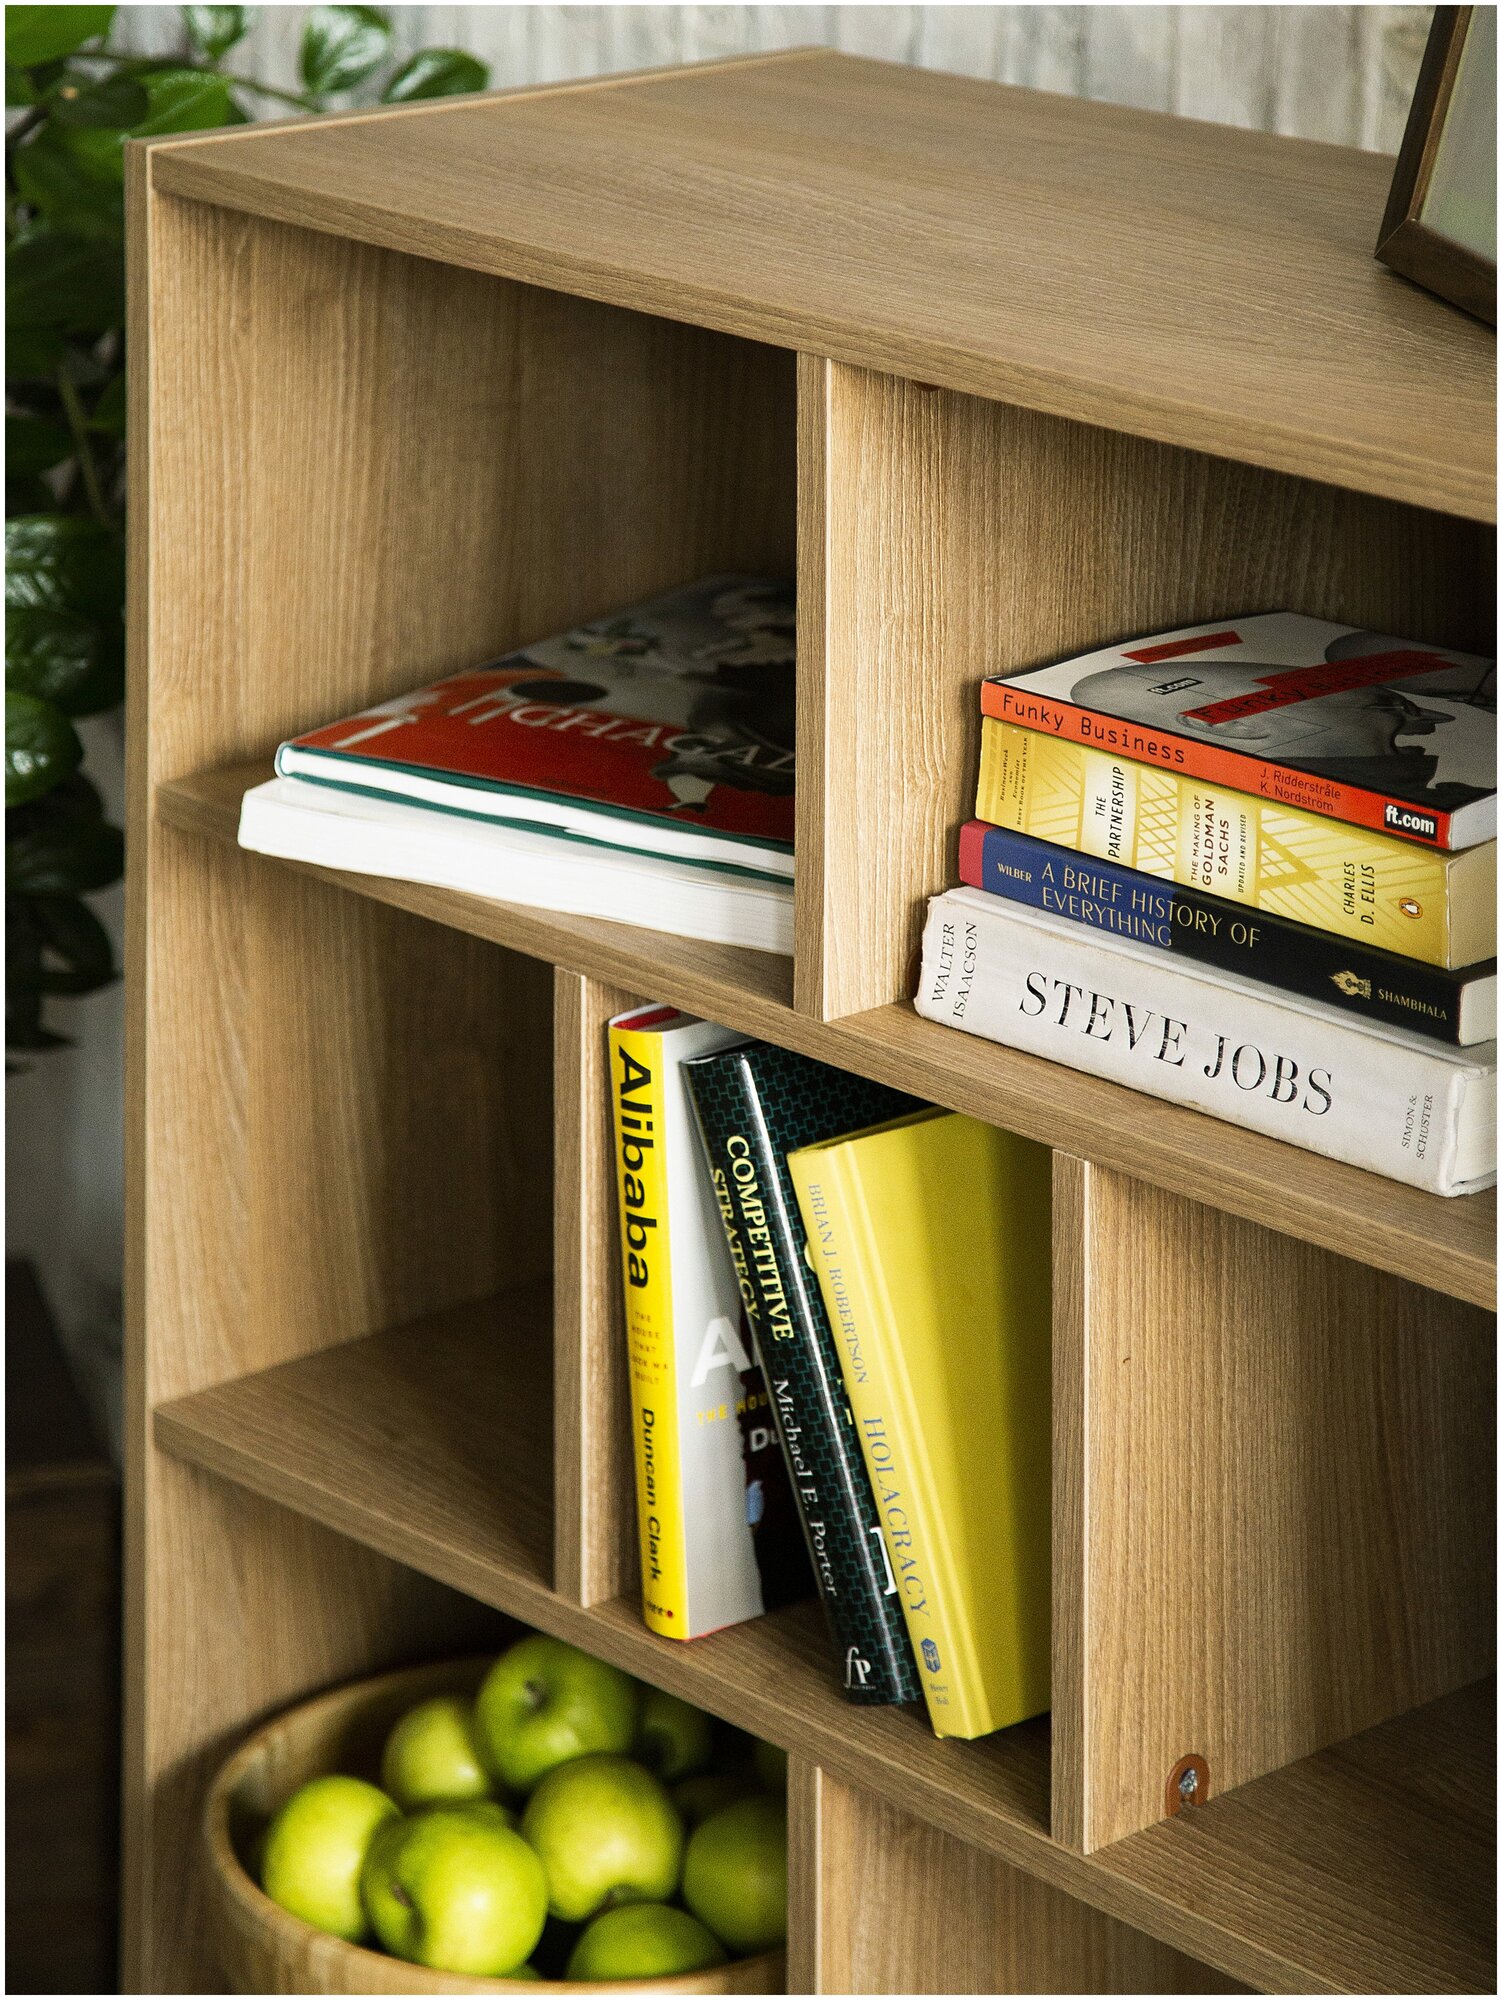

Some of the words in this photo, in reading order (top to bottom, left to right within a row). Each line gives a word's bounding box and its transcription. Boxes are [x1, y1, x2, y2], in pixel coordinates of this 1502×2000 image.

[509, 703, 796, 775] CHAGAL
[1002, 693, 1064, 732] Funky
[1081, 716, 1186, 764] Business
[1095, 796, 1106, 816] THE
[1108, 766, 1125, 858] PARTNERSHIP
[1194, 794, 1201, 810] OF
[1260, 767, 1269, 779] J.
[1273, 770, 1341, 800] Ridderstråle
[1260, 781, 1272, 795] K.
[1274, 785, 1334, 812] Nordström
[1193, 813, 1201, 856] MAKING
[1202, 799, 1215, 886] GOLDMAN
[1218, 819, 1230, 876] SACHS
[1385, 804, 1435, 835] ft.com
[997, 861, 1033, 883] WILBER
[1042, 862, 1055, 883] A
[1063, 866, 1123, 903] BRIEF
[1132, 889, 1222, 936] HISTORY
[1230, 922, 1261, 948] OF
[1238, 861, 1246, 893] UPDATED
[1343, 862, 1355, 915] CHARLES
[1361, 864, 1375, 904] ELLIS
[1042, 886, 1172, 946] EVERYTHING
[1361, 911, 1375, 926] D.
[932, 923, 955, 1002] WALTER
[952, 921, 977, 1018] ISAACSON
[1378, 988, 1448, 1021] SHAMBHALA
[1019, 971, 1187, 1067] STEVE
[1203, 1033, 1333, 1116] JOBS
[1401, 1105, 1416, 1149] SIMON
[1415, 1094, 1434, 1160] SCHUSTER
[618, 1044, 657, 1289] Alibaba
[711, 1167, 761, 1321] STRATEGY
[727, 1135, 795, 1341] COMPETITIVE
[808, 1183, 835, 1244] BRIAN
[823, 1249, 838, 1263] J.
[828, 1267, 870, 1384] ROBERTSON
[641, 1407, 657, 1507] Duncan
[773, 1379, 813, 1477] Michael
[801, 1487, 819, 1512] E.
[810, 1521, 837, 1597] Porter
[647, 1514, 662, 1582] Clark
[863, 1415, 931, 1618] HOLACRACY
